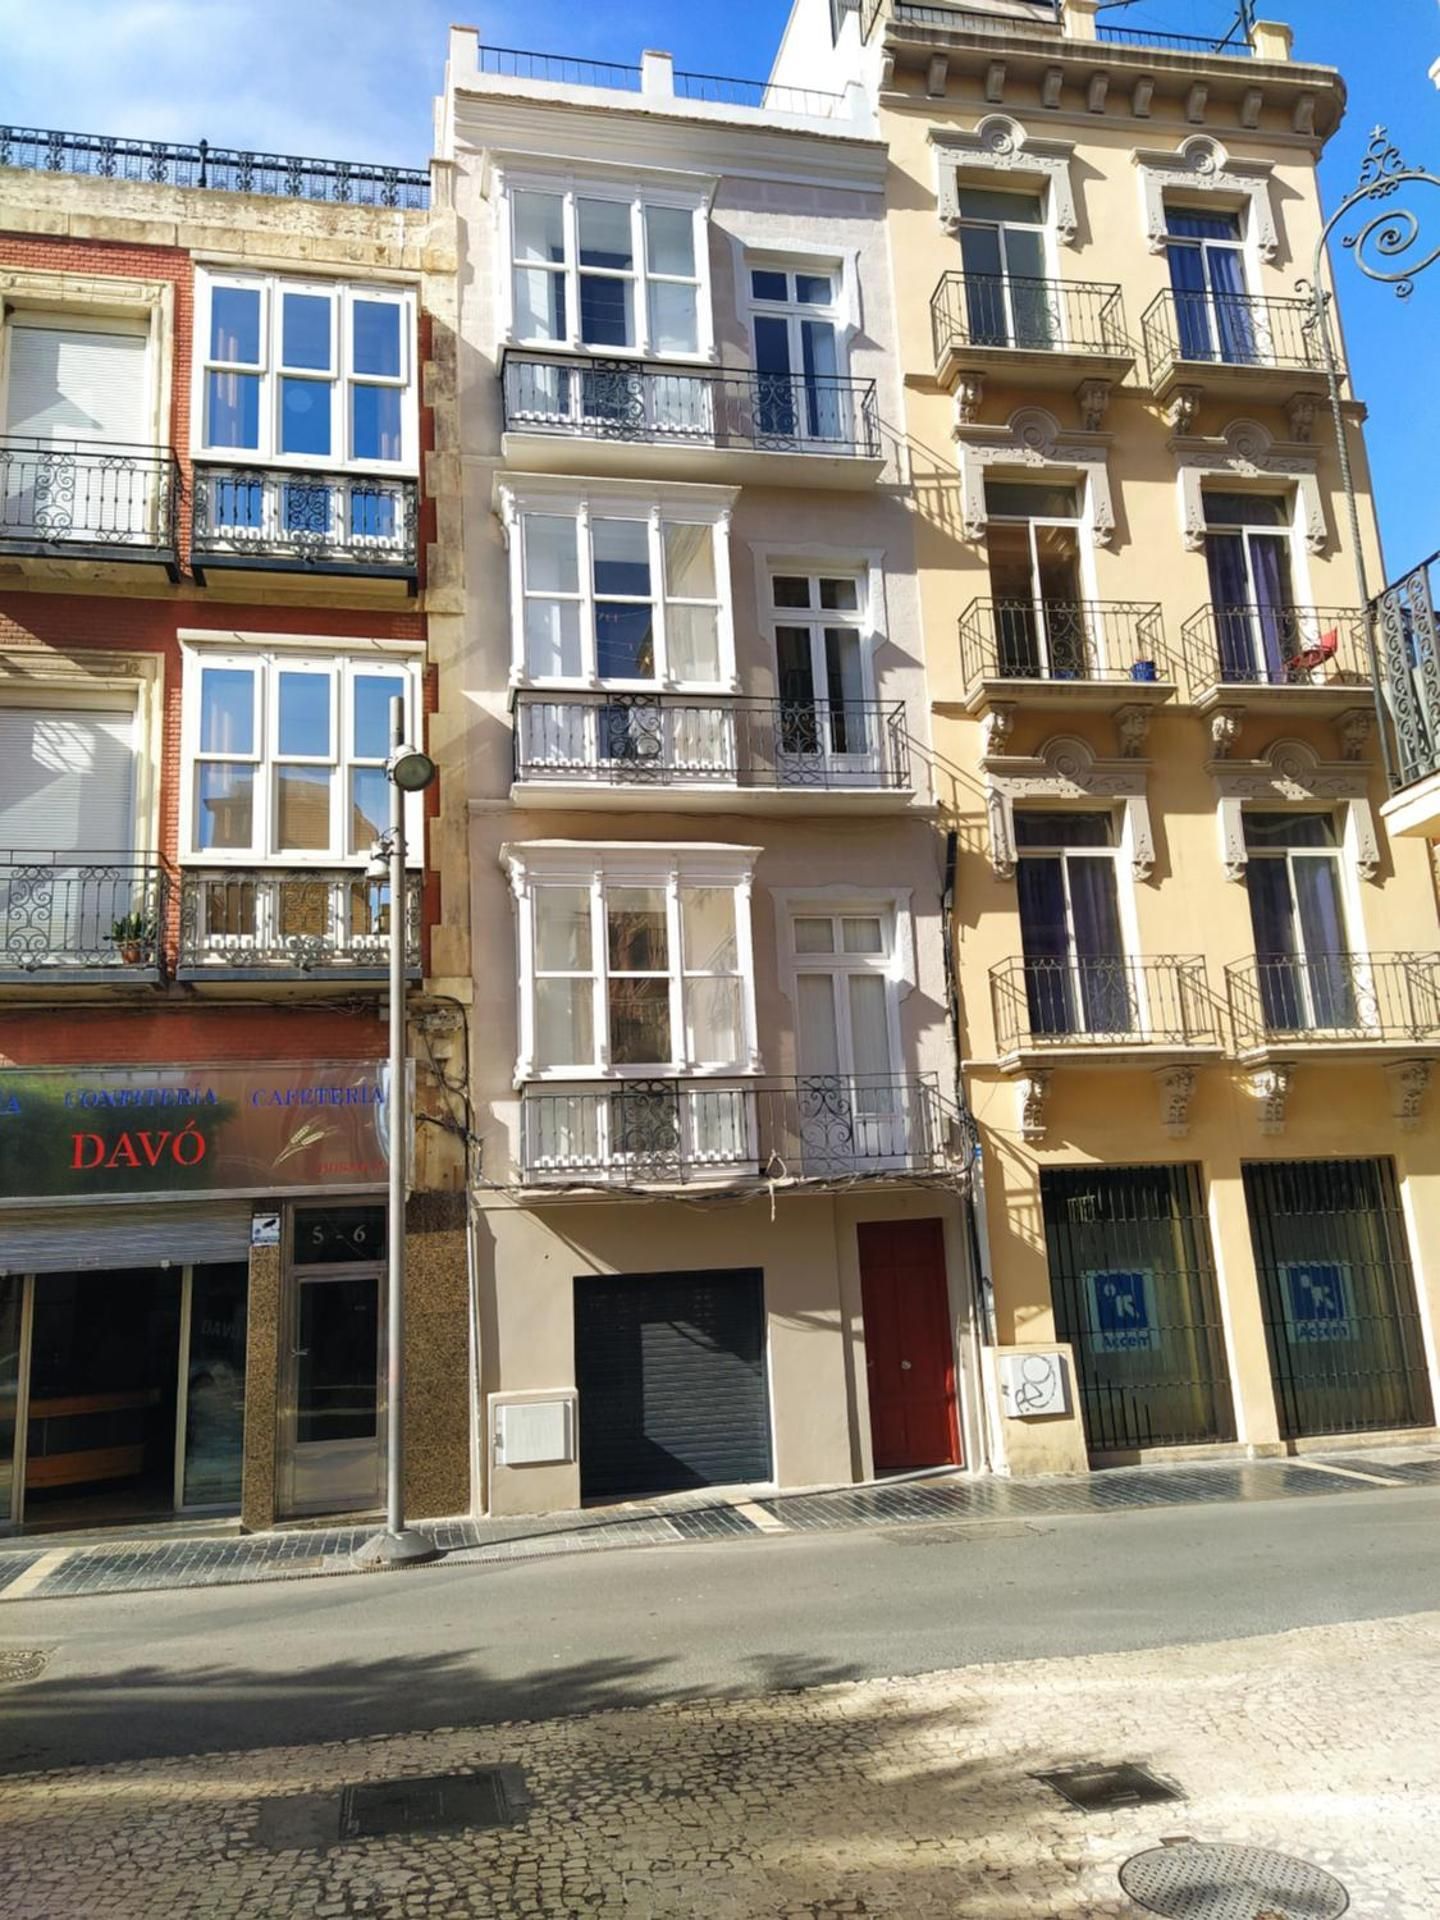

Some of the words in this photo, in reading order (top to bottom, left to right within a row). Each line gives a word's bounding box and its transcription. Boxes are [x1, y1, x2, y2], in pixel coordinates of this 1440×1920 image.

[70, 1119, 207, 1169] DAVÓ
[312, 1226, 325, 1244] 5
[352, 1225, 367, 1243] 6
